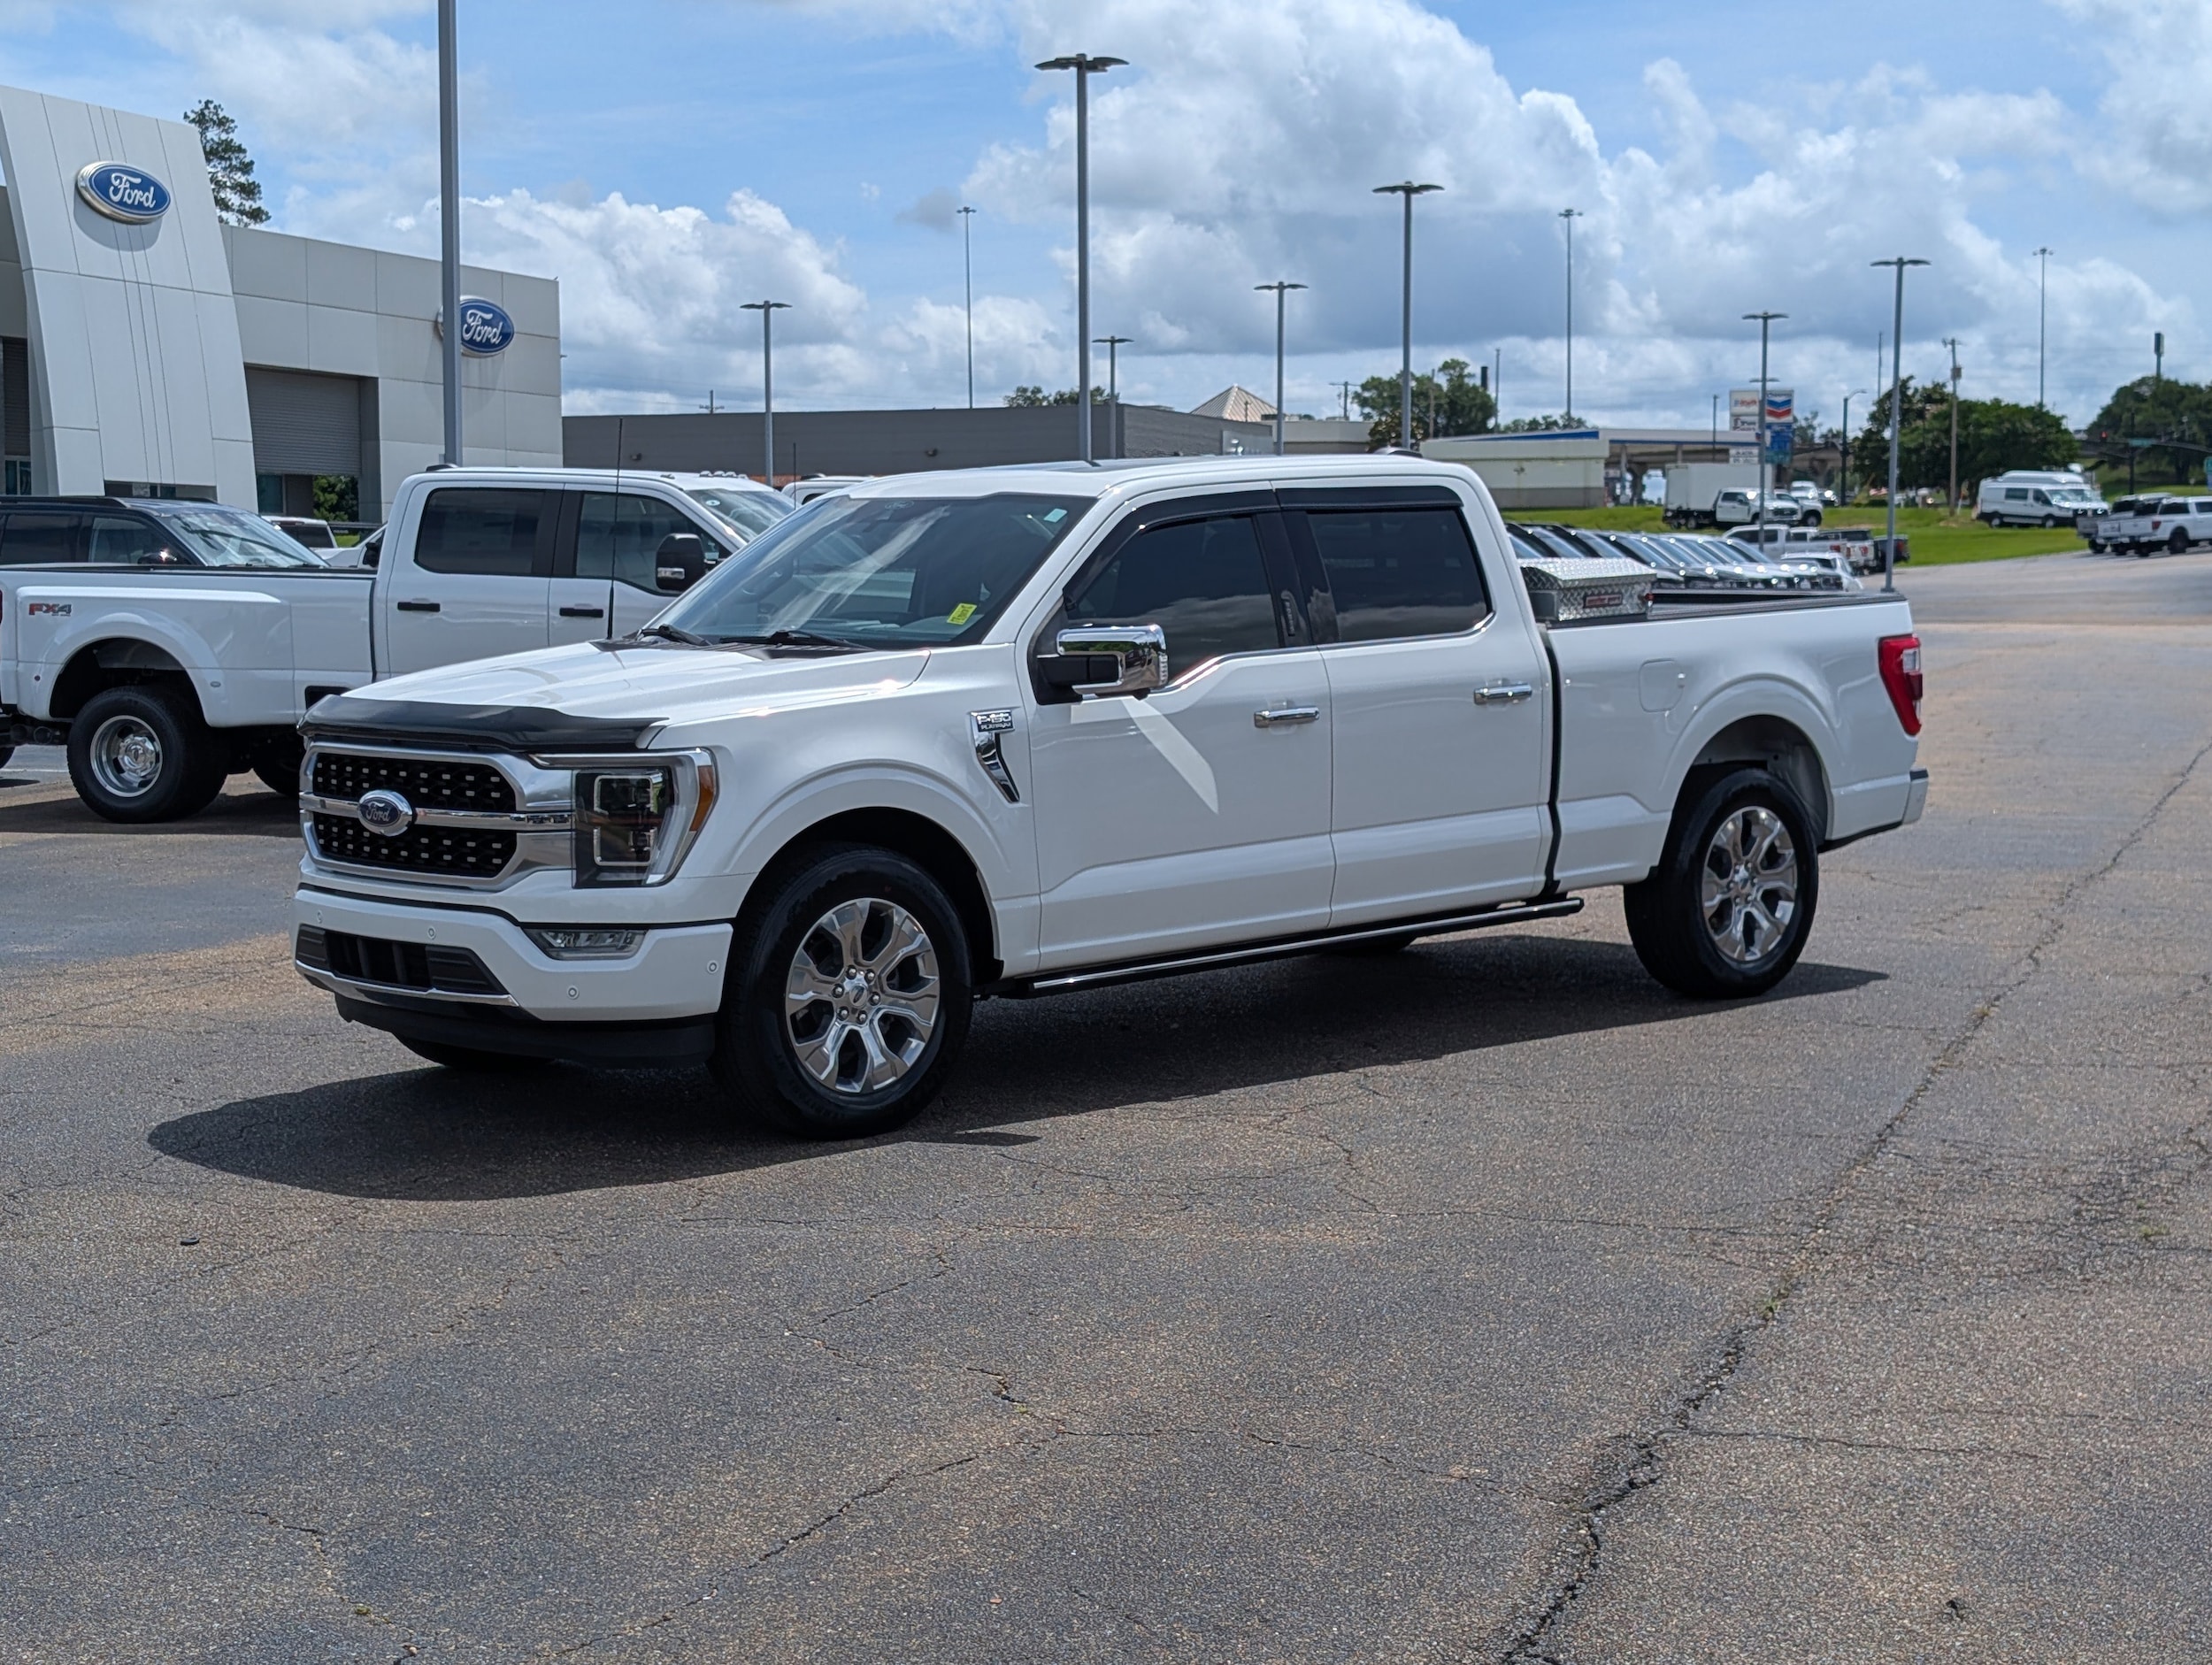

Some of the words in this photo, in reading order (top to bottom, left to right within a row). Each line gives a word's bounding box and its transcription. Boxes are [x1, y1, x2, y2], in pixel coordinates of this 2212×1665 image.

[109, 173, 157, 209] Ford
[462, 309, 503, 345] Ford
[28, 602, 72, 616] FX4
[365, 801, 390, 822] Ford
